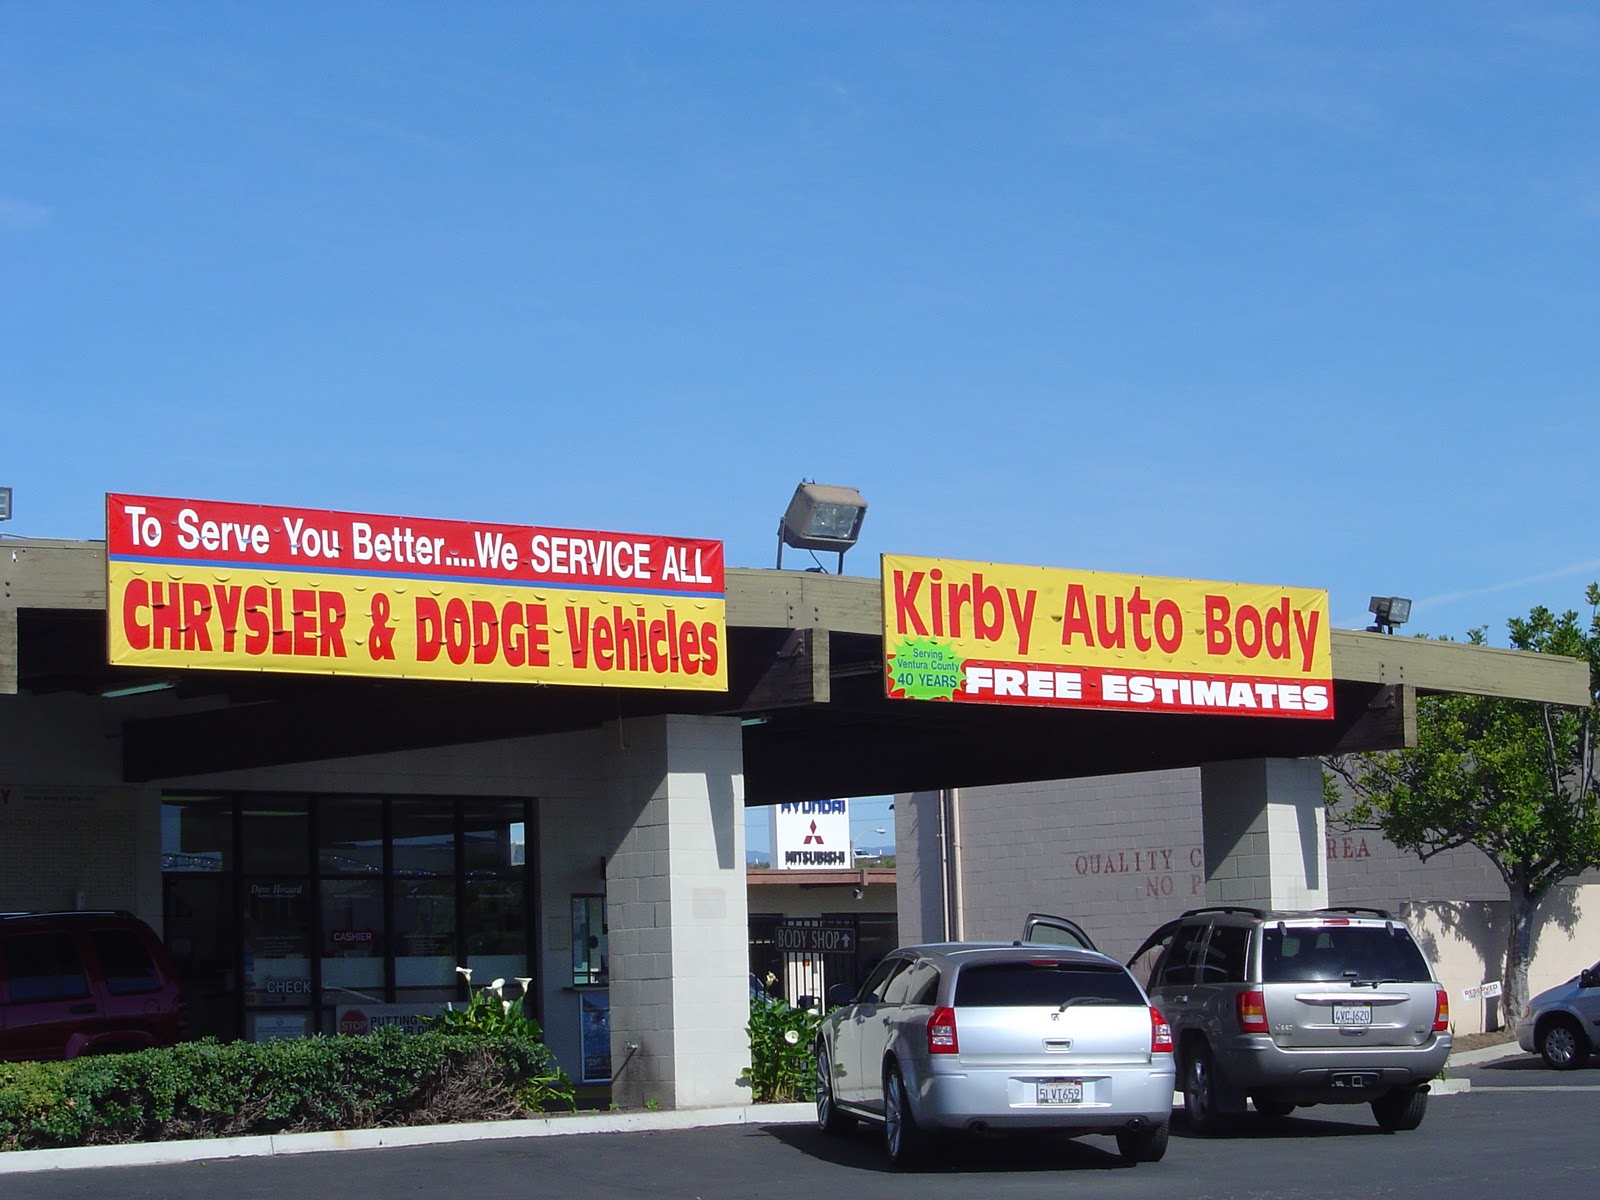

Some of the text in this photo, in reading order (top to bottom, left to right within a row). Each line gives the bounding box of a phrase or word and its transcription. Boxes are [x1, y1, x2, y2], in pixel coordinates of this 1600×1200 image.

[124, 506, 163, 547] To
[177, 508, 270, 554] Serve
[282, 516, 341, 559] You
[531, 534, 651, 580] SERVICE
[661, 545, 713, 584] ALL
[122, 577, 719, 677] CHRYSLER & DODGE Vehicles
[893, 568, 1321, 673] Kirby Auto Body
[912, 647, 943, 661] Serving
[897, 658, 960, 673] Ventura County
[897, 672, 957, 688] 40 YEARS
[965, 666, 1329, 712] FREE ESTIMATES
[1326, 836, 1371, 860] REA
[785, 851, 845, 865] MITSUBISHI
[1075, 849, 1174, 875] QUALITY
[1145, 875, 1173, 897] NO
[333, 932, 372, 942] CASHIER
[777, 929, 840, 950] BODY SHOP
[266, 980, 313, 994] CHECK
[1464, 983, 1498, 996] RESERVED
[341, 1021, 367, 1032] STOP
[370, 1015, 418, 1027] PUTTING
